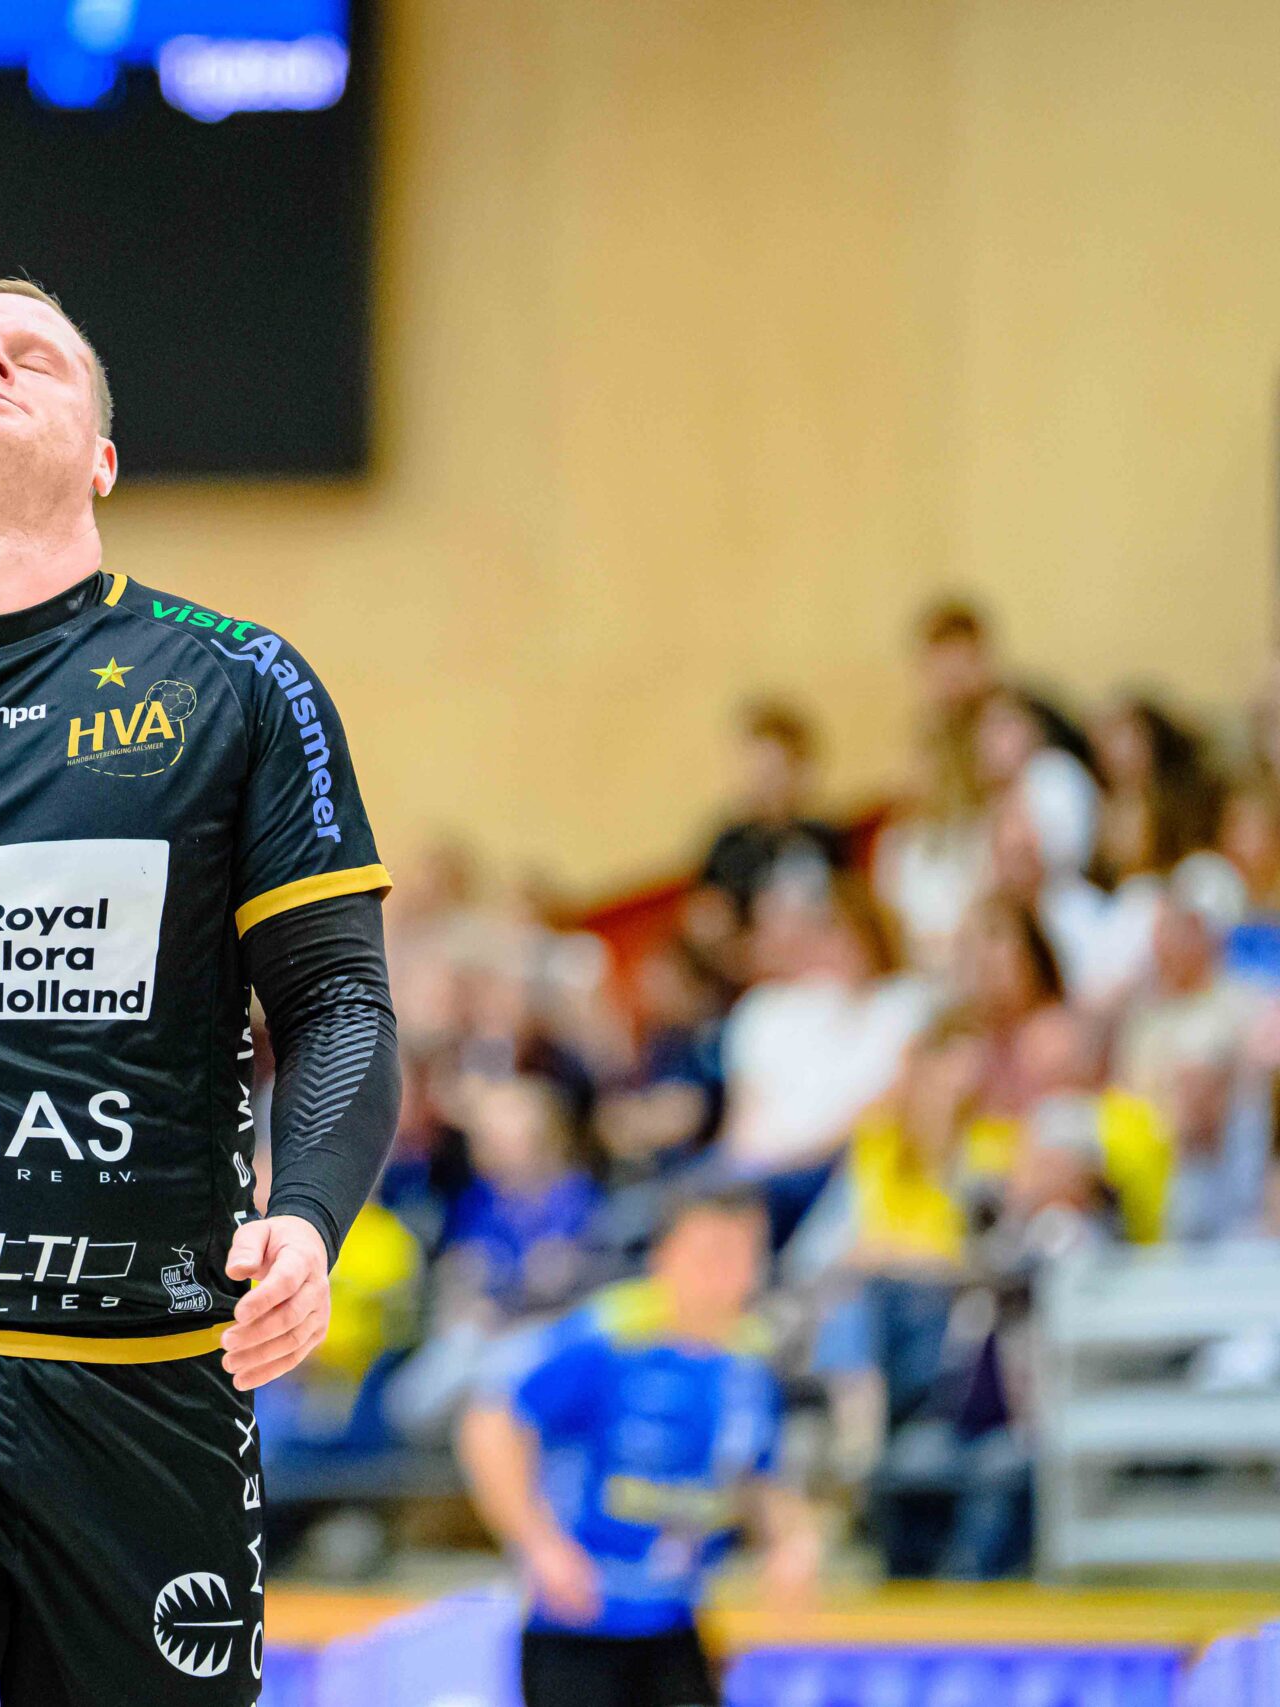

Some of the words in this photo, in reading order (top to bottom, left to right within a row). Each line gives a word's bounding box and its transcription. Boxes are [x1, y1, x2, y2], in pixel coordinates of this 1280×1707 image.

[152, 600, 257, 641] visit
[67, 700, 175, 758] HVA
[132, 742, 164, 753] AALSMEER
[214, 634, 341, 843] Aalsmeer
[99, 1171, 137, 1184] B.V.
[164, 1267, 181, 1284] club
[174, 1292, 207, 1310] winkel
